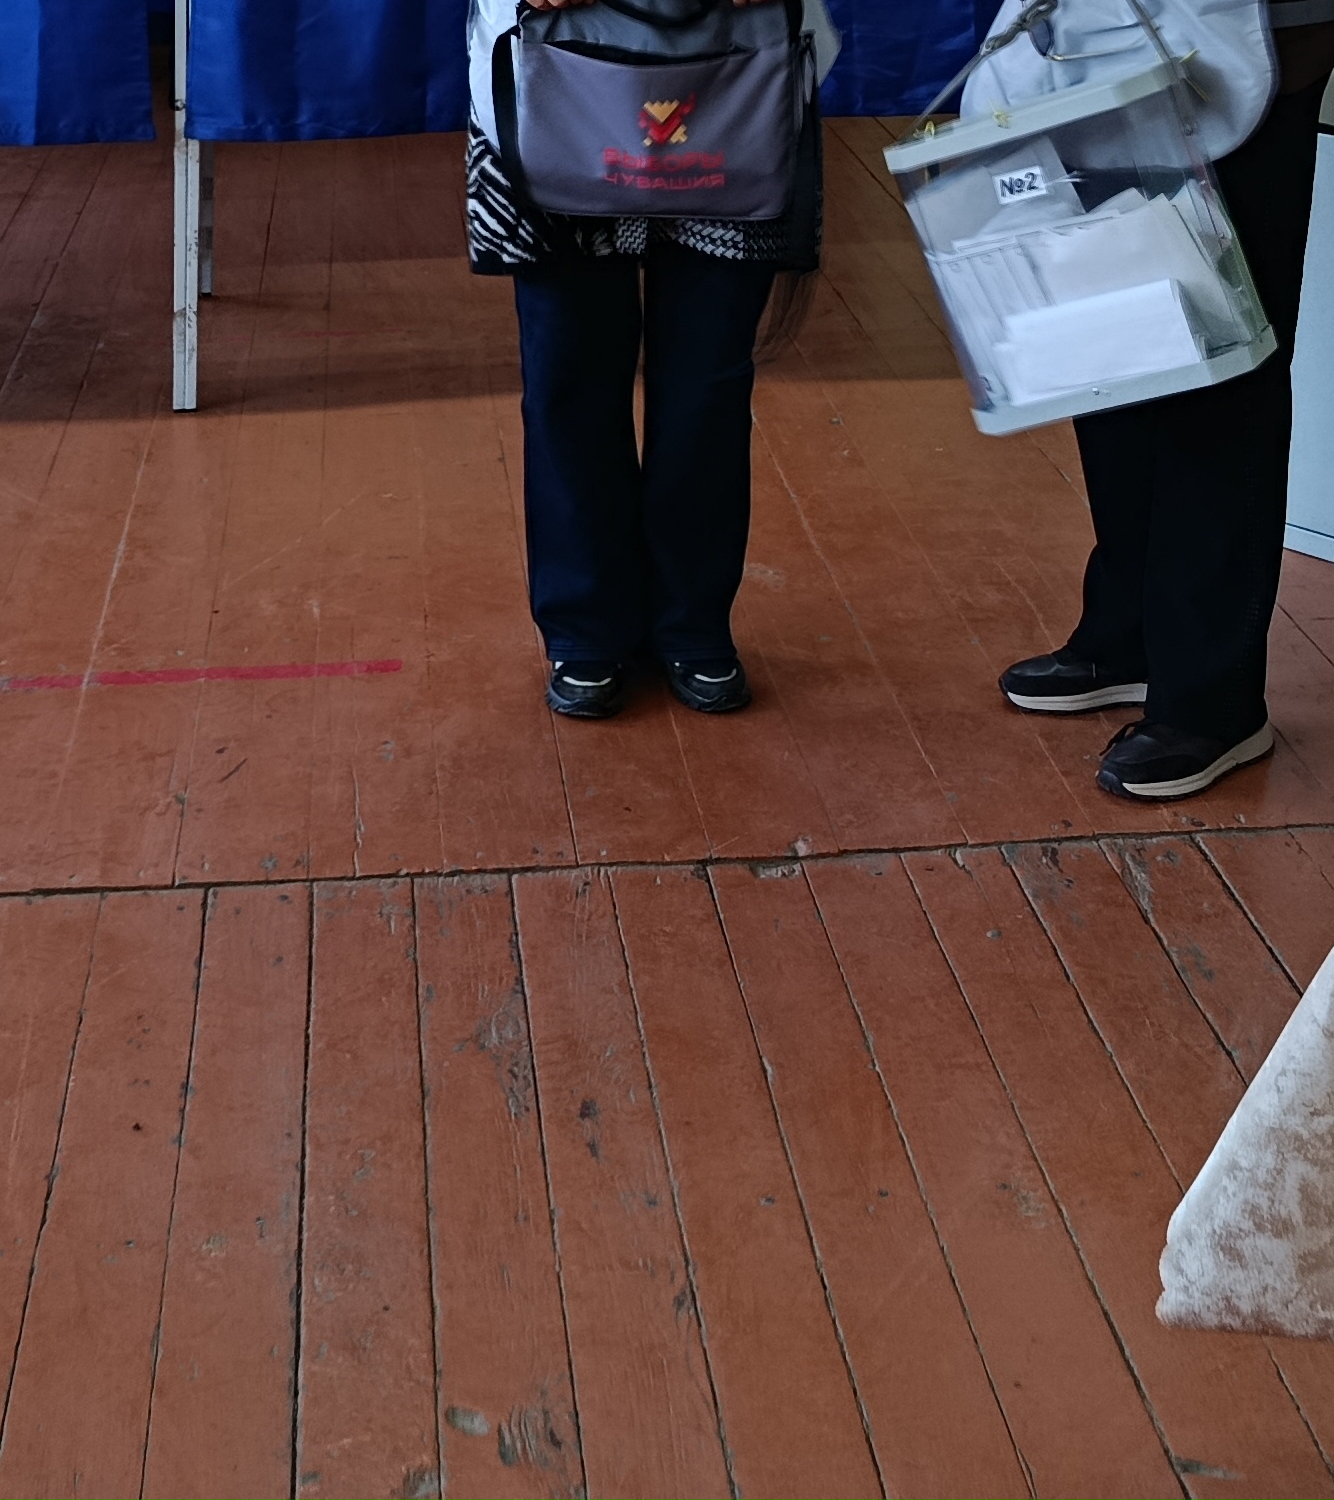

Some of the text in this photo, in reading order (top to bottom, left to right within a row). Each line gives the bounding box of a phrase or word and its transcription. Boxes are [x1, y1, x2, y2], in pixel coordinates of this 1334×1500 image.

[603, 148, 724, 172] ВЫБОРЫ
[603, 173, 725, 190] ЧУВАШИЯ
[999, 171, 1040, 198] №2
